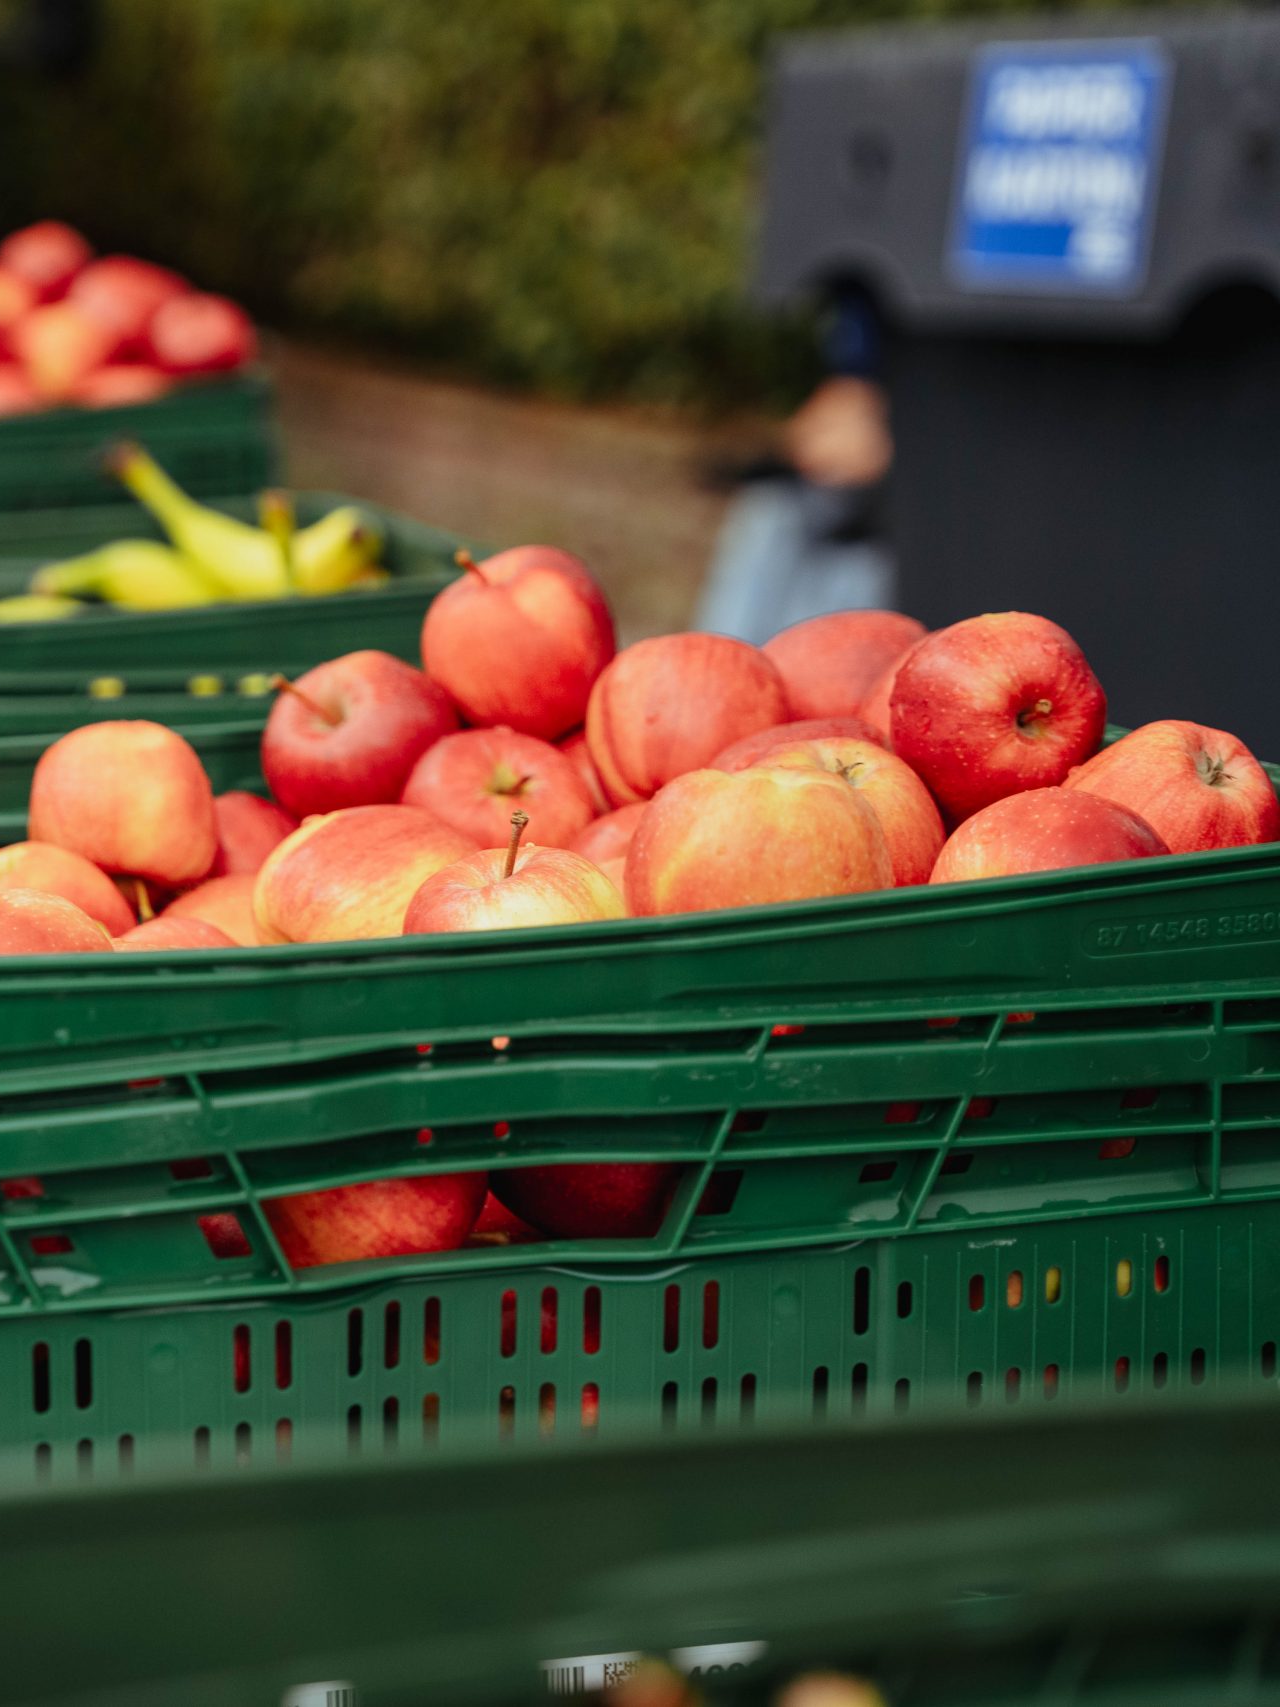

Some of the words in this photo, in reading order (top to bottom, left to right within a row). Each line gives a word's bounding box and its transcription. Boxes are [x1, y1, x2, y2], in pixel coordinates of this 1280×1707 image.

[1096, 925, 1128, 947] 87
[1136, 918, 1210, 944] 14548
[1216, 911, 1280, 937] 3580
